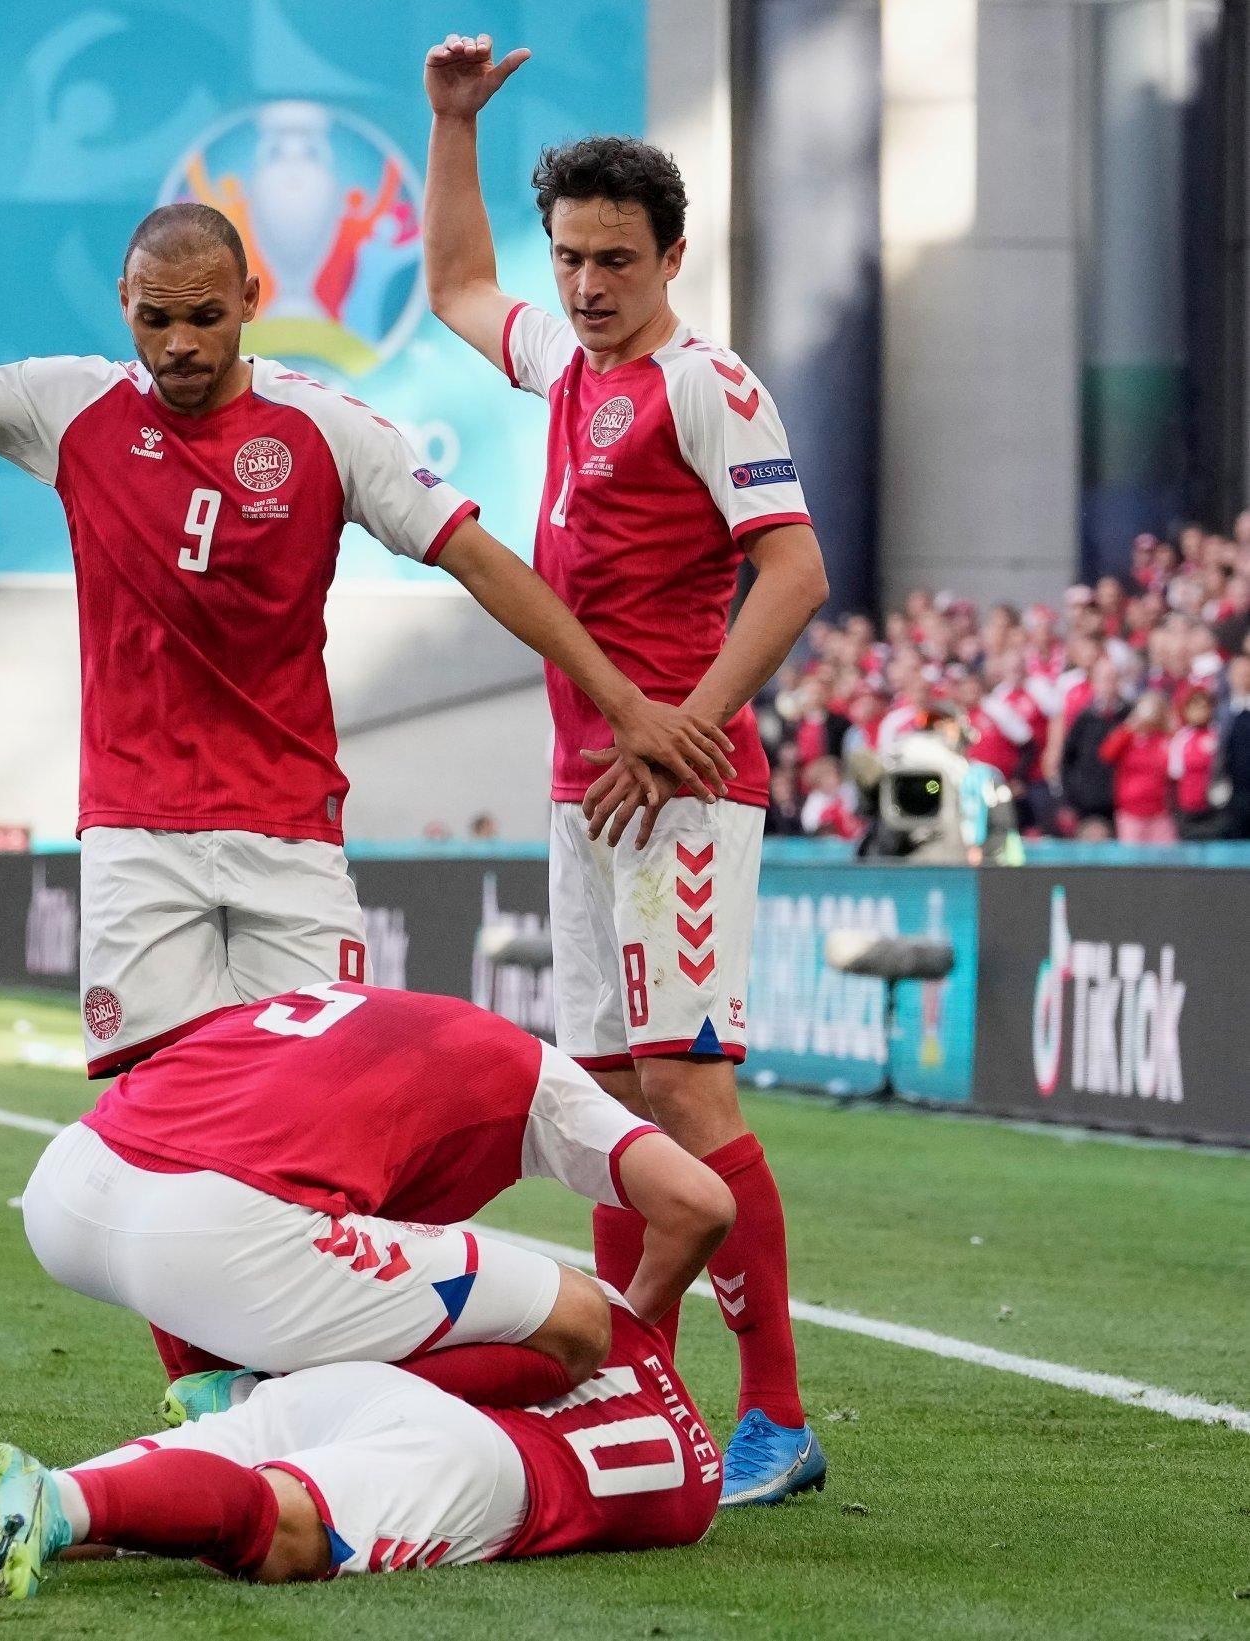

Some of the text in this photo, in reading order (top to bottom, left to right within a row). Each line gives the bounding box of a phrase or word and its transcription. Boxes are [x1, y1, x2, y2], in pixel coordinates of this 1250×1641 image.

[600, 414, 626, 429] DBU
[131, 445, 164, 460] hummel
[247, 455, 279, 473] DBU
[750, 465, 795, 479] RESPECT
[178, 487, 222, 573] 9
[623, 942, 649, 1028] 8
[92, 1002, 115, 1023] DBU
[1071, 940, 1186, 1104] TikTok
[524, 1366, 685, 1497] 10
